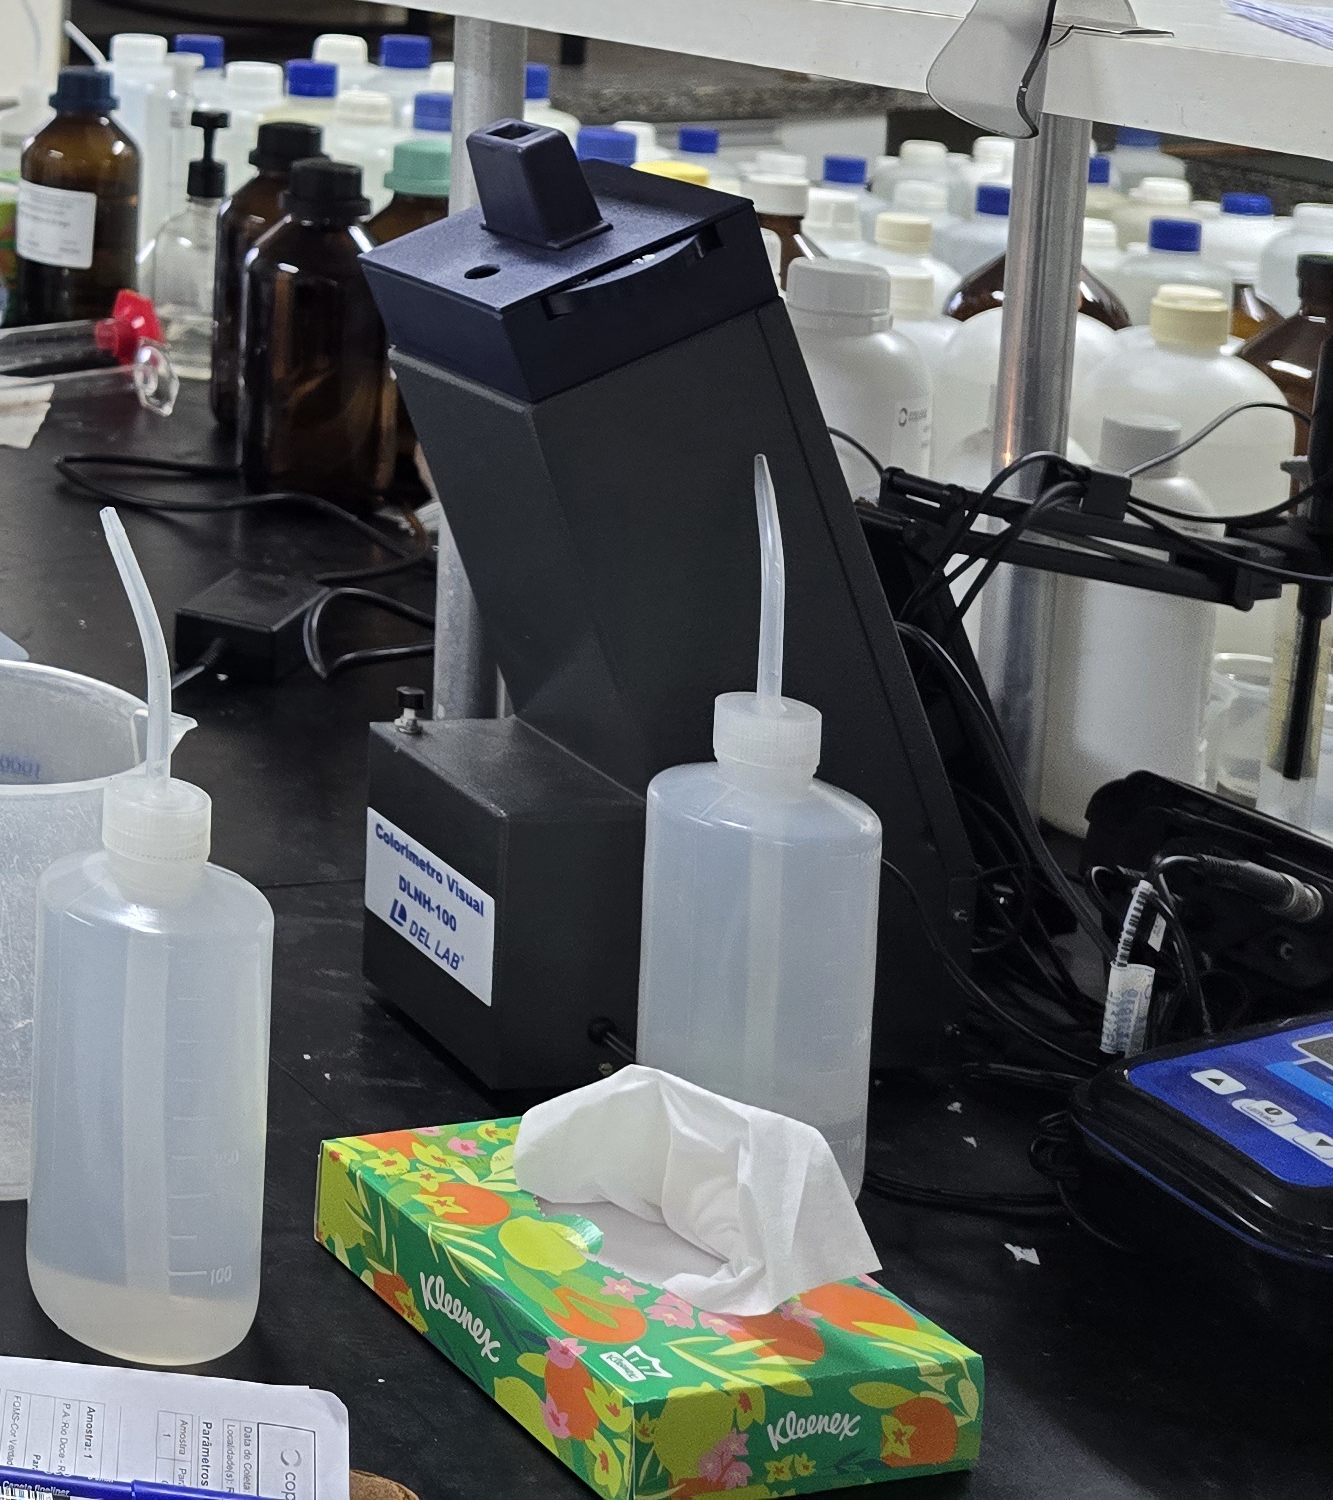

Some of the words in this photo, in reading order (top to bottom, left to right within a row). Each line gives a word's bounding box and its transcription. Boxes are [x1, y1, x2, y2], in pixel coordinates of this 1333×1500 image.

[398, 874, 458, 932] DLNH-100
[446, 873, 484, 917] Visual
[409, 920, 431, 950] DEL
[210, 1264, 234, 1286] 100
[419, 1271, 502, 1363] Kleenex
[58, 1436, 69, 1459] Doce
[84, 1405, 96, 1451] Amostra:
[179, 1419, 189, 1456] Amostra
[243, 1426, 253, 1446] Data
[766, 1410, 862, 1452] Kleenex
[6, 1438, 17, 1466] Verdad
[200, 1421, 213, 1487] Parâmetros
[224, 1424, 235, 1486] Localidade(s):
